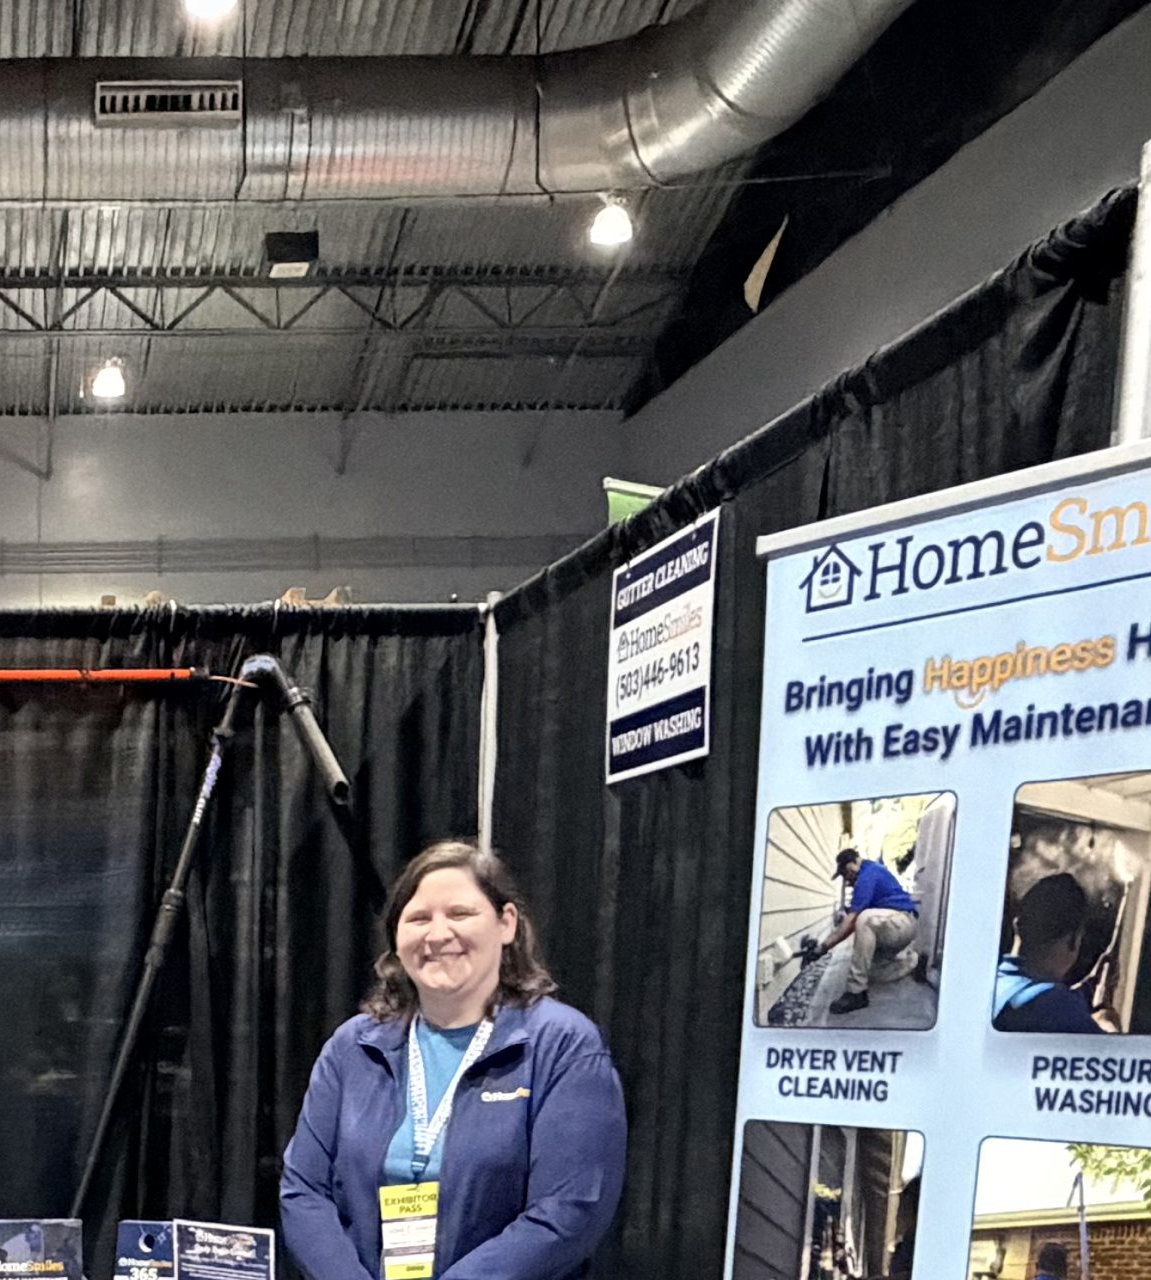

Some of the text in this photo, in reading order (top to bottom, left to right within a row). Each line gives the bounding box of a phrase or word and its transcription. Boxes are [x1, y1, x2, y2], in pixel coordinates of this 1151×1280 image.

[617, 541, 710, 611] GUTTER CLEANING
[629, 601, 703, 658] HomeSmiles
[616, 641, 700, 708] (503)446-9613
[785, 667, 914, 715] Bringing
[923, 634, 1117, 692] Happiness
[612, 706, 702, 757] WINDOW WASHING
[805, 727, 873, 768] With
[882, 722, 961, 761] Easy
[765, 1047, 903, 1074] DRYER VENT
[777, 1075, 889, 1102] CLEANING
[399, 1203, 423, 1214] PASS
